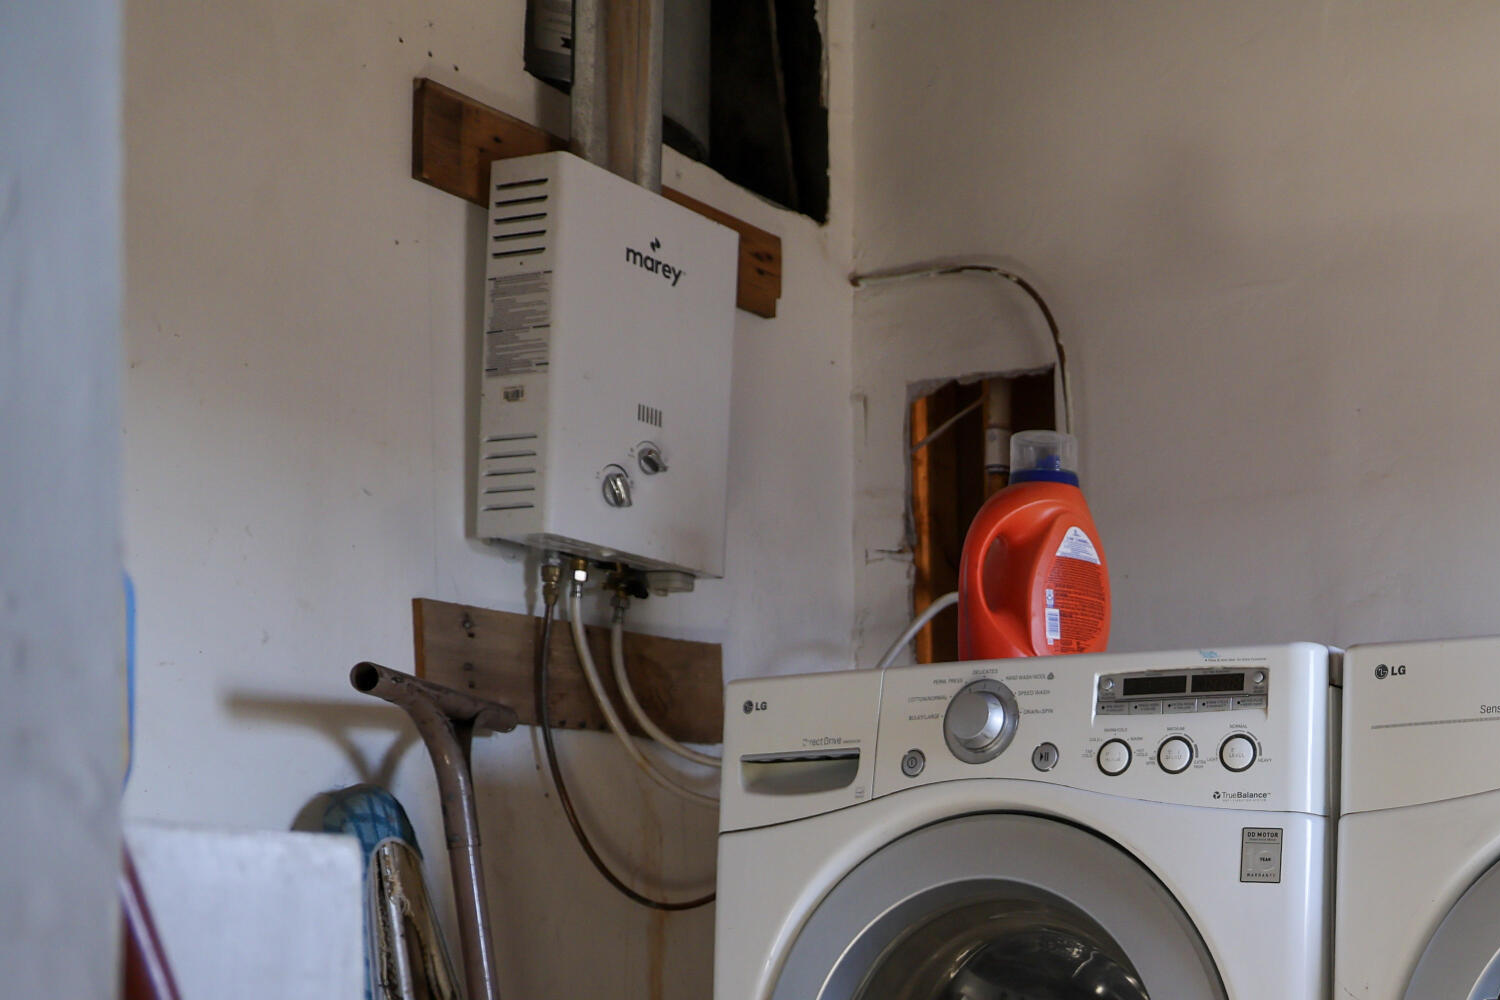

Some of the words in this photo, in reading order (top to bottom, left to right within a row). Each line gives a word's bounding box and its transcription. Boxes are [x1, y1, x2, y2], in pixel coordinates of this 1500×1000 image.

[625, 247, 682, 287] marey
[1391, 665, 1406, 676] LG
[755, 701, 768, 711] LG
